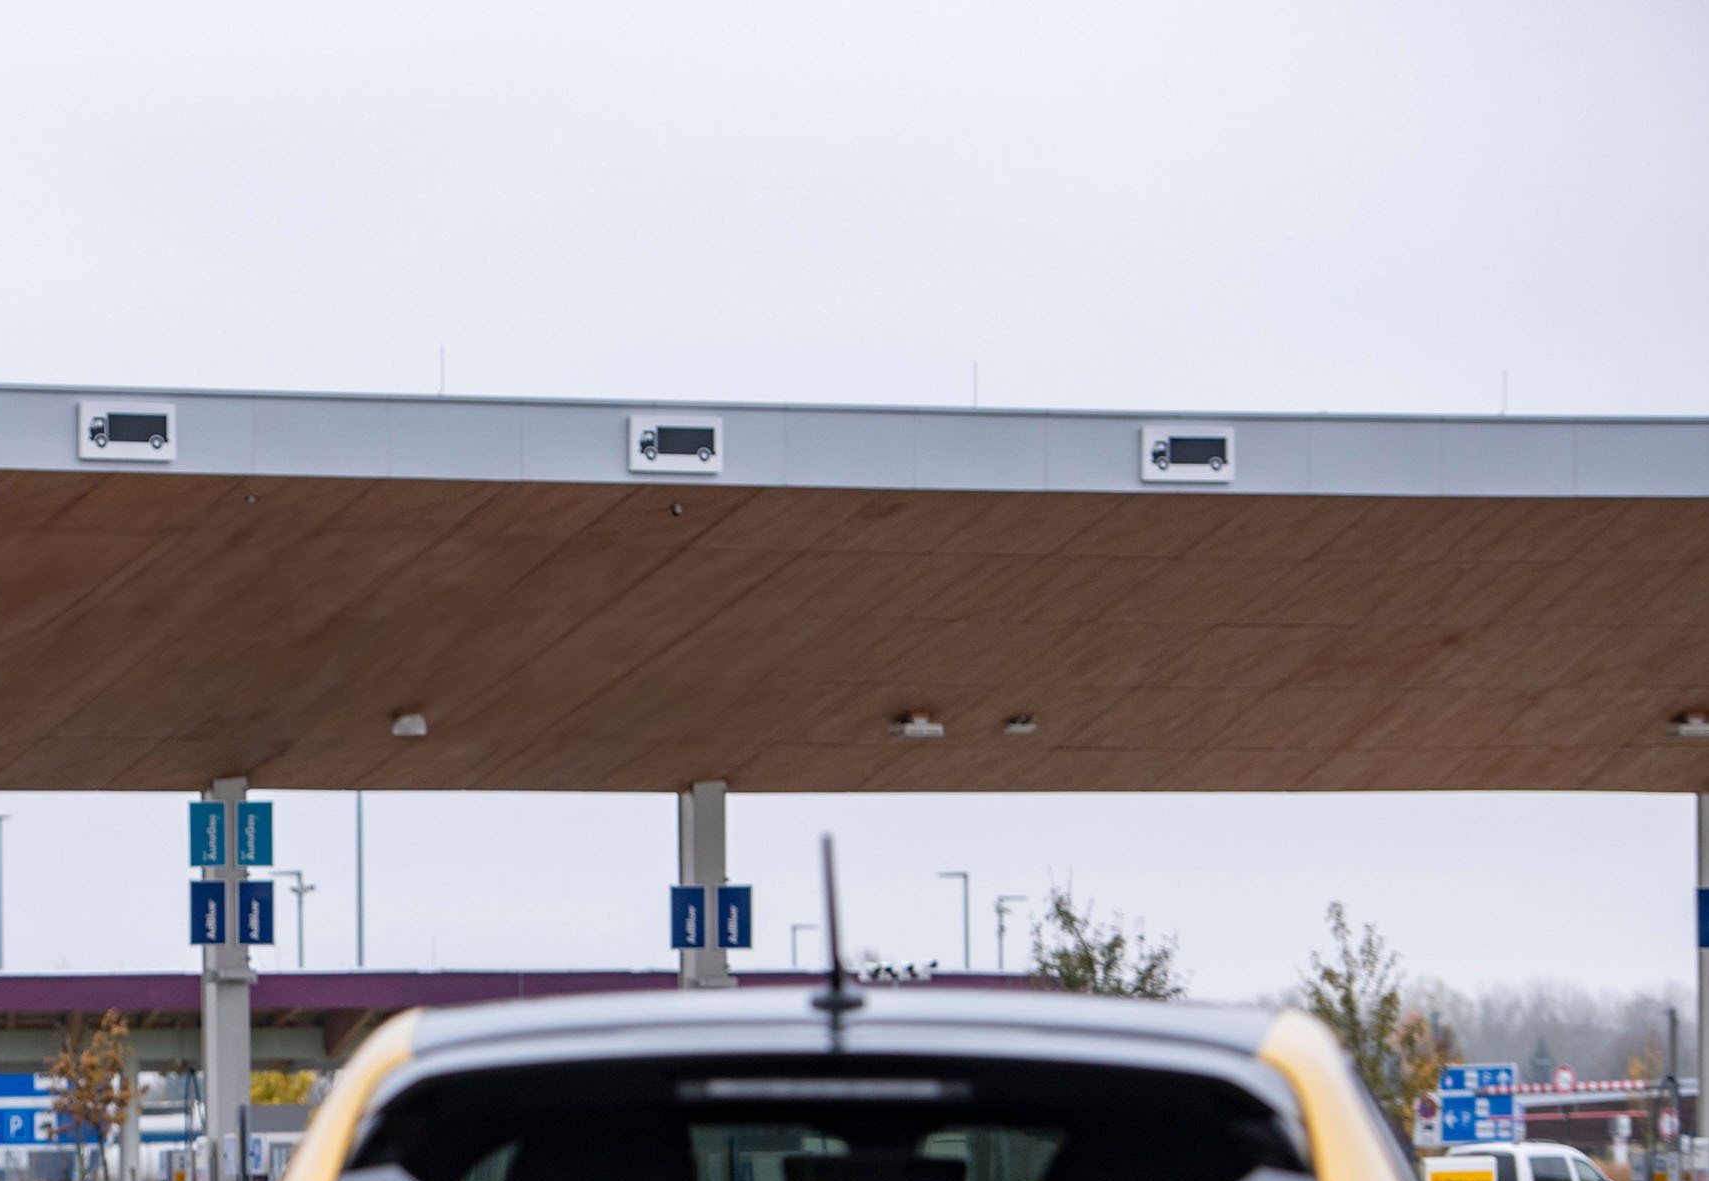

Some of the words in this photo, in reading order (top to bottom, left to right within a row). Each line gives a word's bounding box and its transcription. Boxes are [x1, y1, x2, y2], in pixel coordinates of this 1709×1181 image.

[205, 899, 217, 941] AdBlue
[249, 899, 260, 941] AdBlue
[685, 903, 697, 945] AdBlue
[727, 903, 738, 945] AdBlue
[9, 1114, 23, 1138] P
